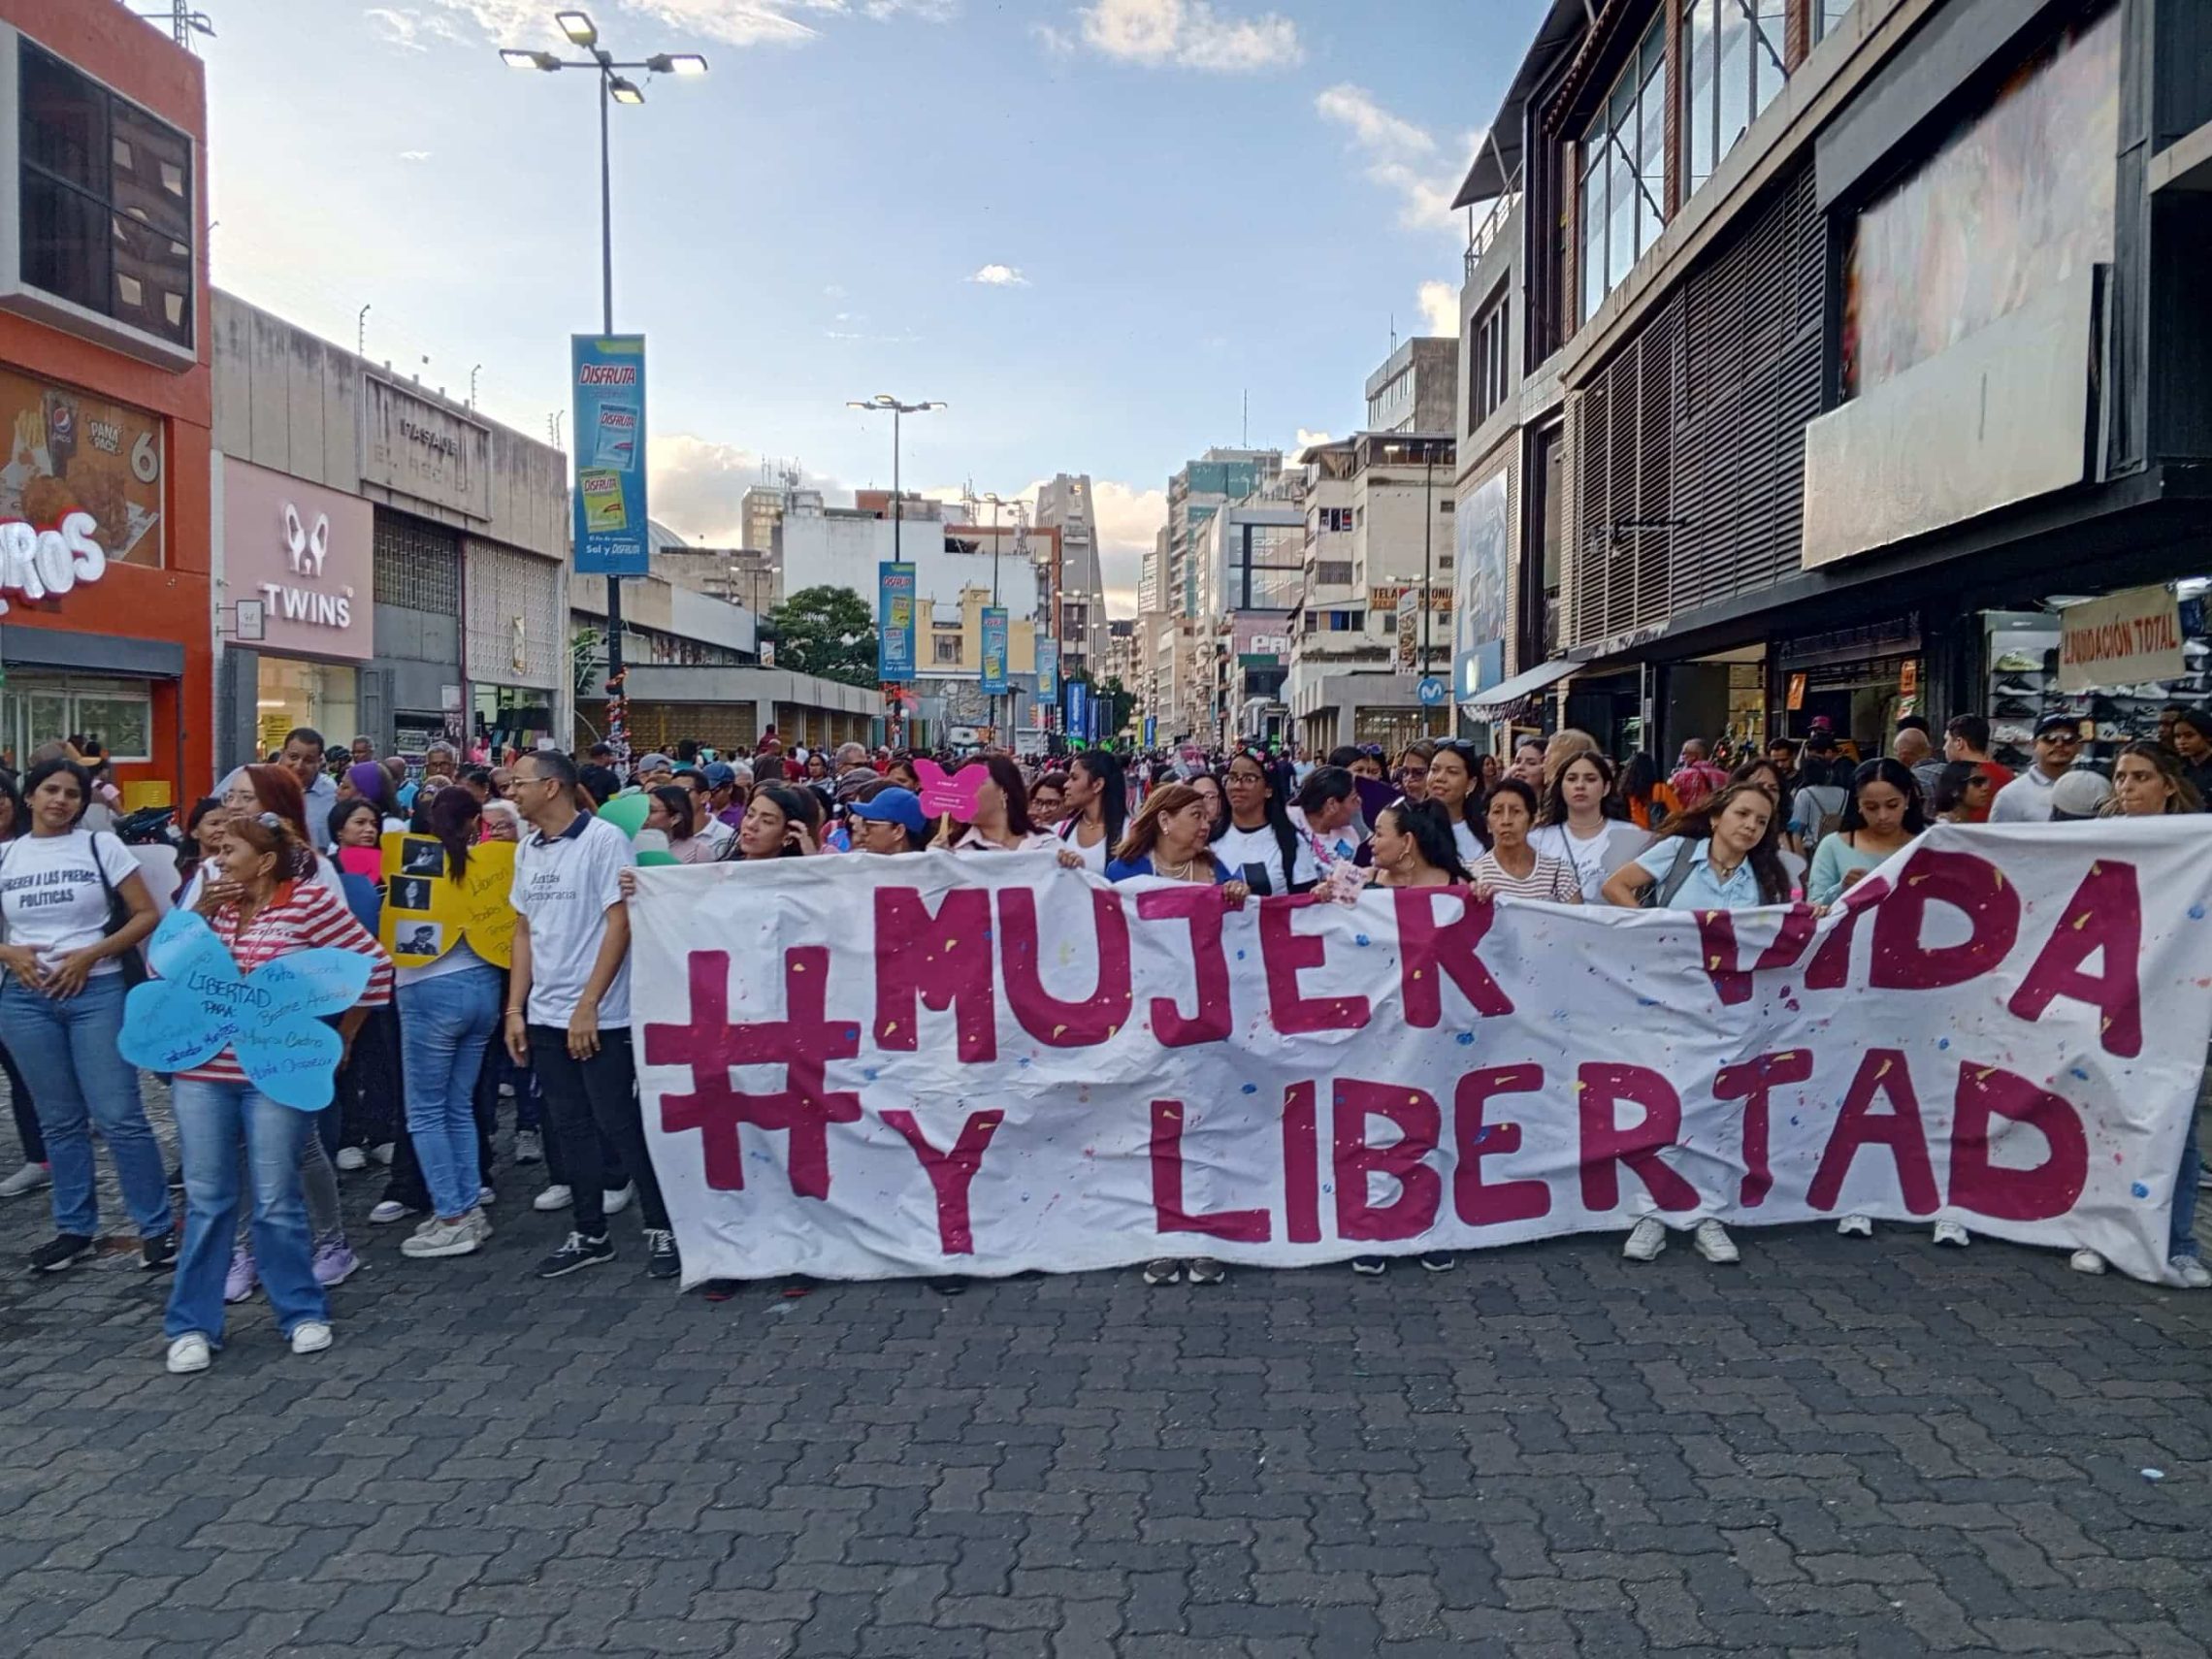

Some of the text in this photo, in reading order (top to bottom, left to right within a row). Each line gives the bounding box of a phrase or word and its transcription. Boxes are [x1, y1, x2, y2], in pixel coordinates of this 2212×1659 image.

[579, 364, 636, 385] DISFRUTA
[131, 432, 158, 483] 6
[0, 512, 106, 600] ROS
[586, 544, 602, 553] Sal
[263, 582, 350, 628] TWINS
[2134, 611, 2178, 653] TOTAL
[44, 870, 59, 885] LAS
[20, 889, 74, 908] POLÍTICAS
[187, 971, 272, 1008] LIBERTAD
[879, 1048, 2089, 1255] Y LIBERTAD
